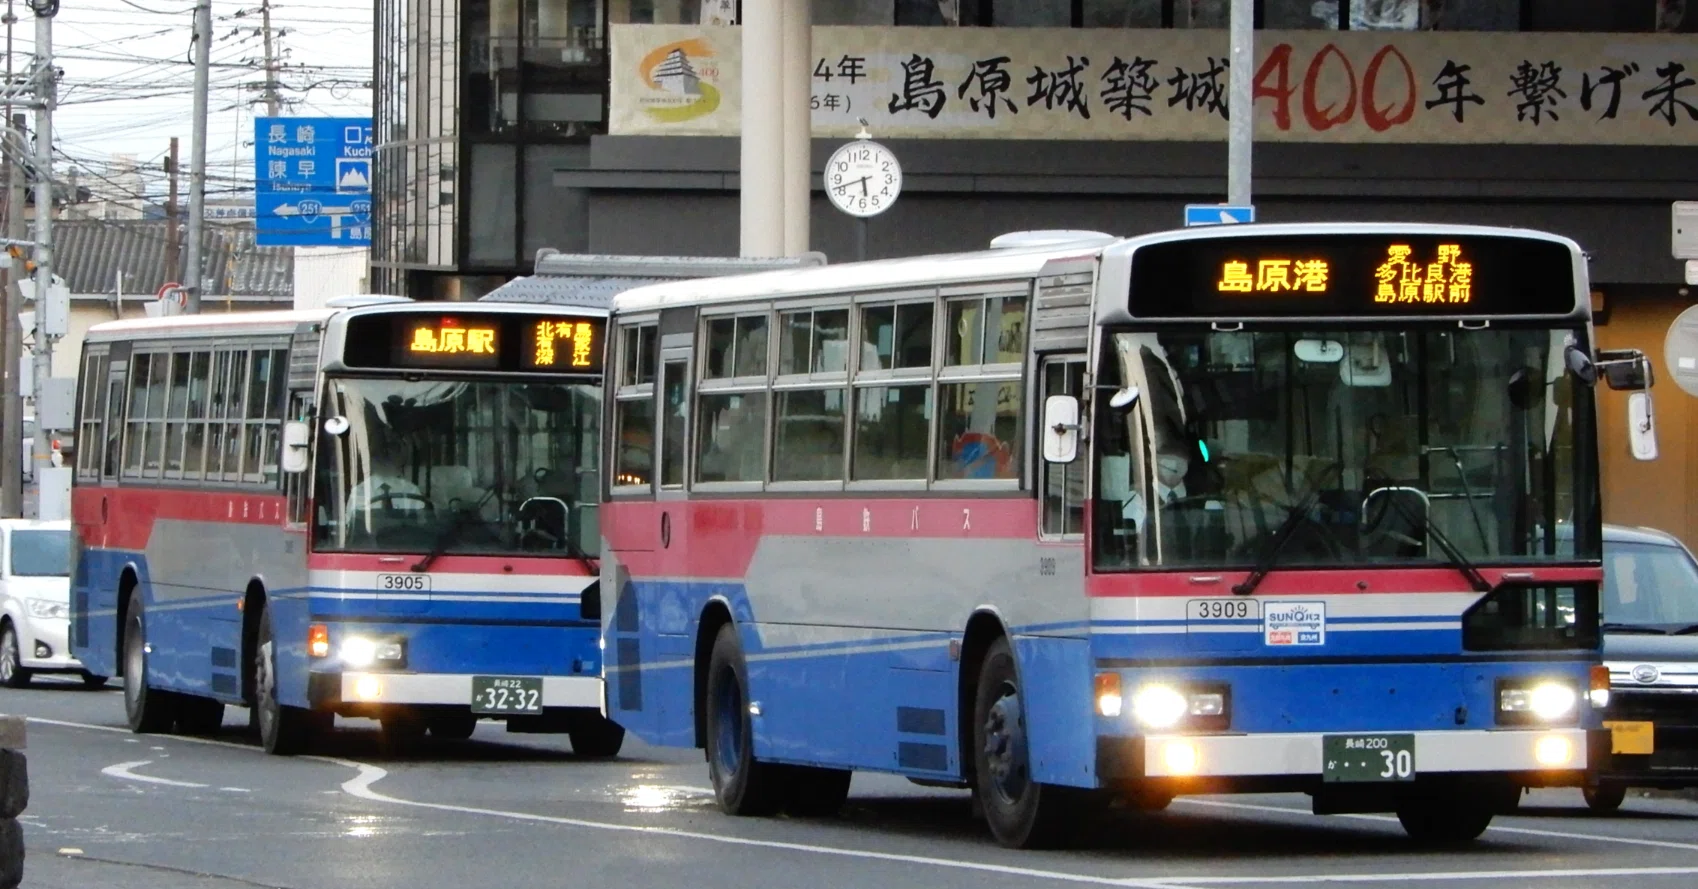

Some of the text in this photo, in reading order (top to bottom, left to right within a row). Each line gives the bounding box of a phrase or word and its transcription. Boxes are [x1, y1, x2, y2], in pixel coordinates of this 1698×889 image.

[268, 124, 315, 144] 長崎
[268, 146, 316, 158] Nagasaki
[848, 152, 857, 163] 11
[859, 149, 870, 161] 12
[875, 152, 879, 163] 1
[837, 161, 848, 172] 10
[881, 161, 889, 172] 2
[834, 174, 842, 185] 9
[884, 174, 893, 185] 3
[838, 185, 846, 196] 8
[880, 186, 888, 196] 4
[848, 195, 856, 206] 7
[859, 198, 867, 209] 6
[871, 195, 879, 206] 5
[301, 203, 319, 215] 251
[1218, 259, 1329, 292] 島原港
[1374, 263, 1472, 284] 多比良港
[1374, 282, 1471, 304] 島原駅前
[411, 328, 495, 353] 島原駅
[384, 576, 424, 590] 3905
[1198, 601, 1248, 618] 3909
